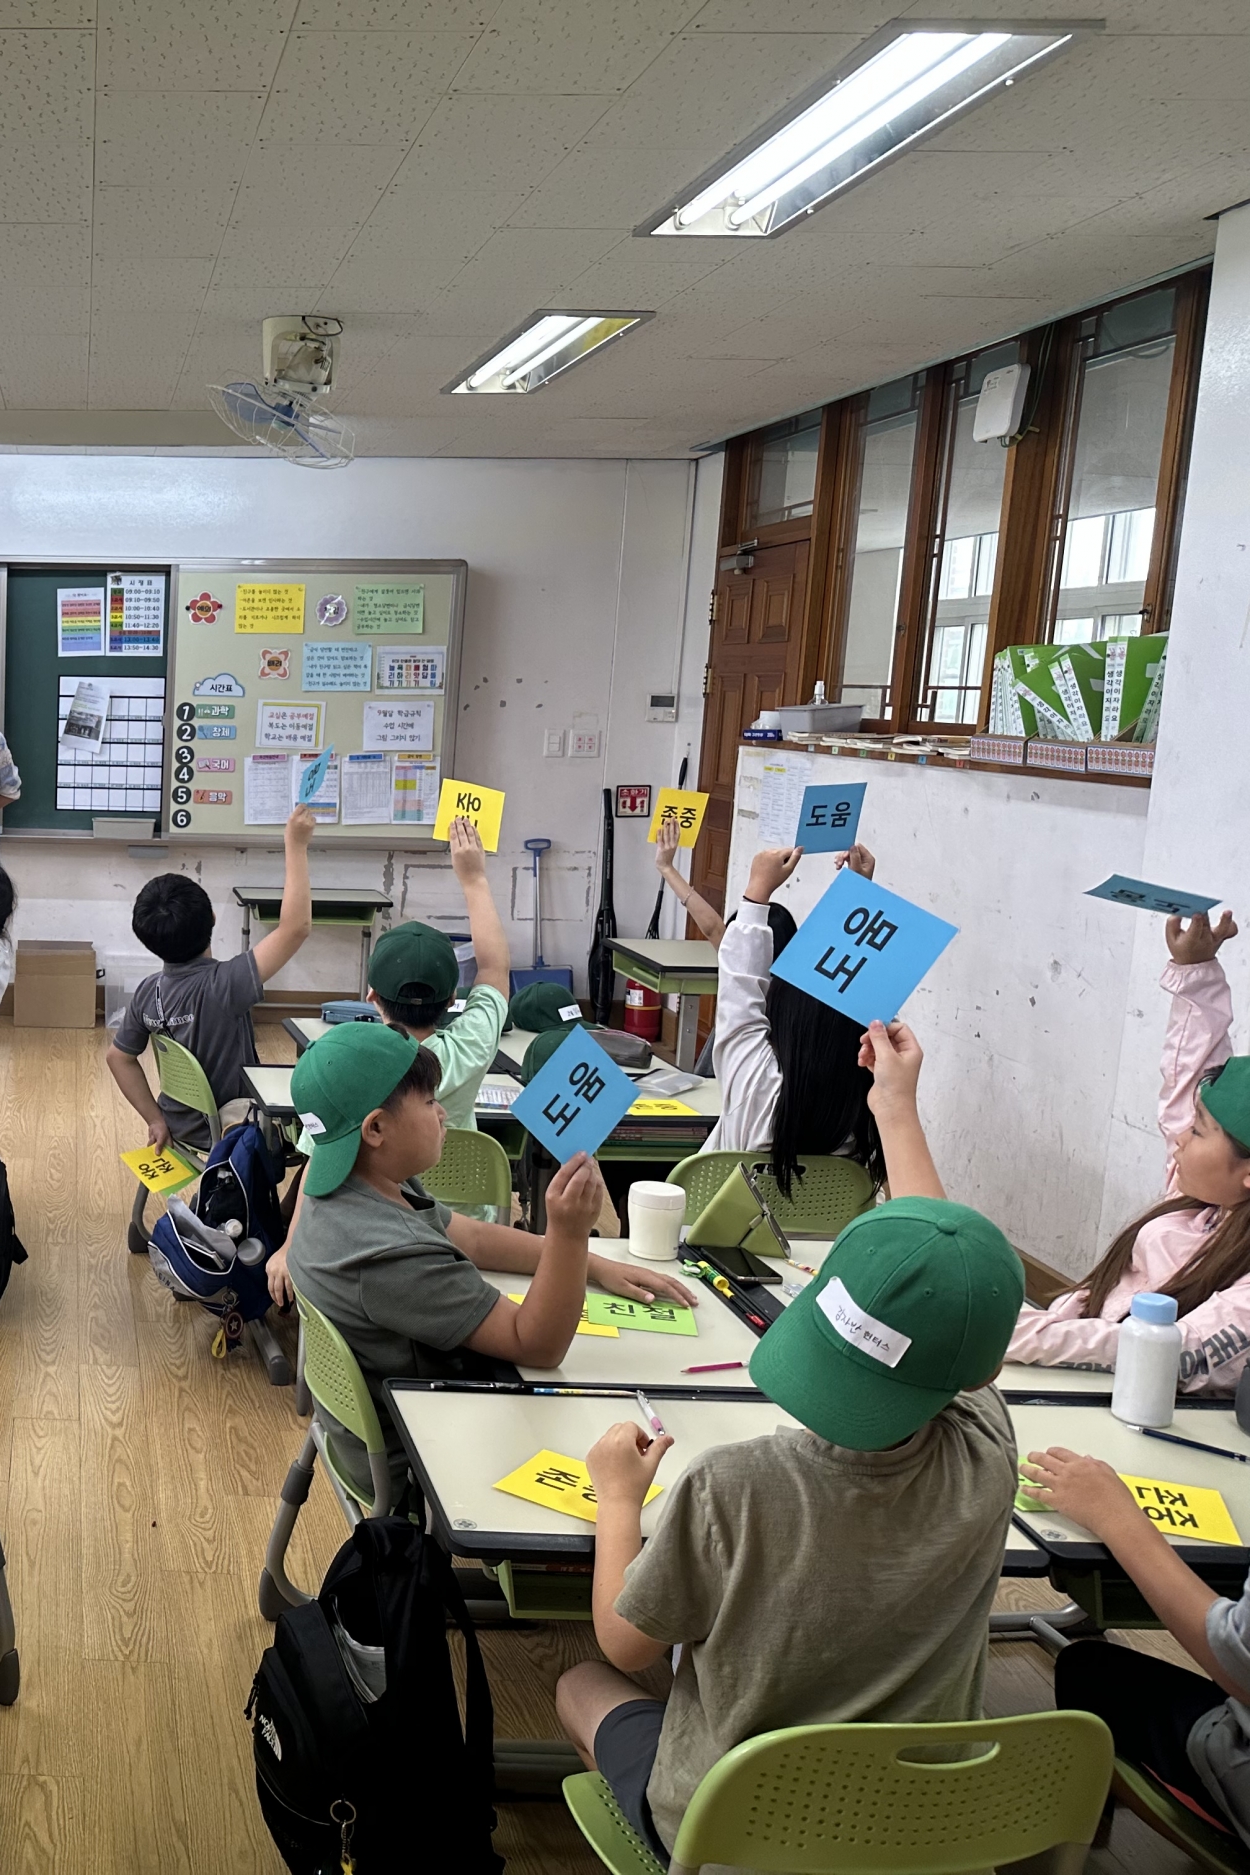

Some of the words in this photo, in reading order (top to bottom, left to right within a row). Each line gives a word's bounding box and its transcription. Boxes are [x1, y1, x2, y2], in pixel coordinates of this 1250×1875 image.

[210, 684, 233, 692] 시간표
[183, 706, 189, 719] 1
[211, 705, 229, 716] 과학
[182, 726, 191, 739] 2
[268, 722, 287, 730] 복도는
[398, 722, 414, 730] 시간에
[264, 733, 284, 741] 학교는
[300, 734, 312, 742] 예절
[179, 749, 191, 763] 3
[212, 759, 229, 769] 국어
[179, 767, 189, 781] 4
[177, 788, 187, 802] 5
[209, 791, 227, 802] 음악
[621, 789, 647, 797] 소화기
[177, 812, 187, 825] 6
[805, 801, 852, 828] 도움
[813, 907, 899, 994] 도움
[541, 1061, 606, 1137] 도움
[138, 1157, 175, 1181] 존중
[603, 1301, 677, 1321] 친절
[863, 1331, 890, 1352] 헌터스
[1135, 1486, 1199, 1529] 존중
